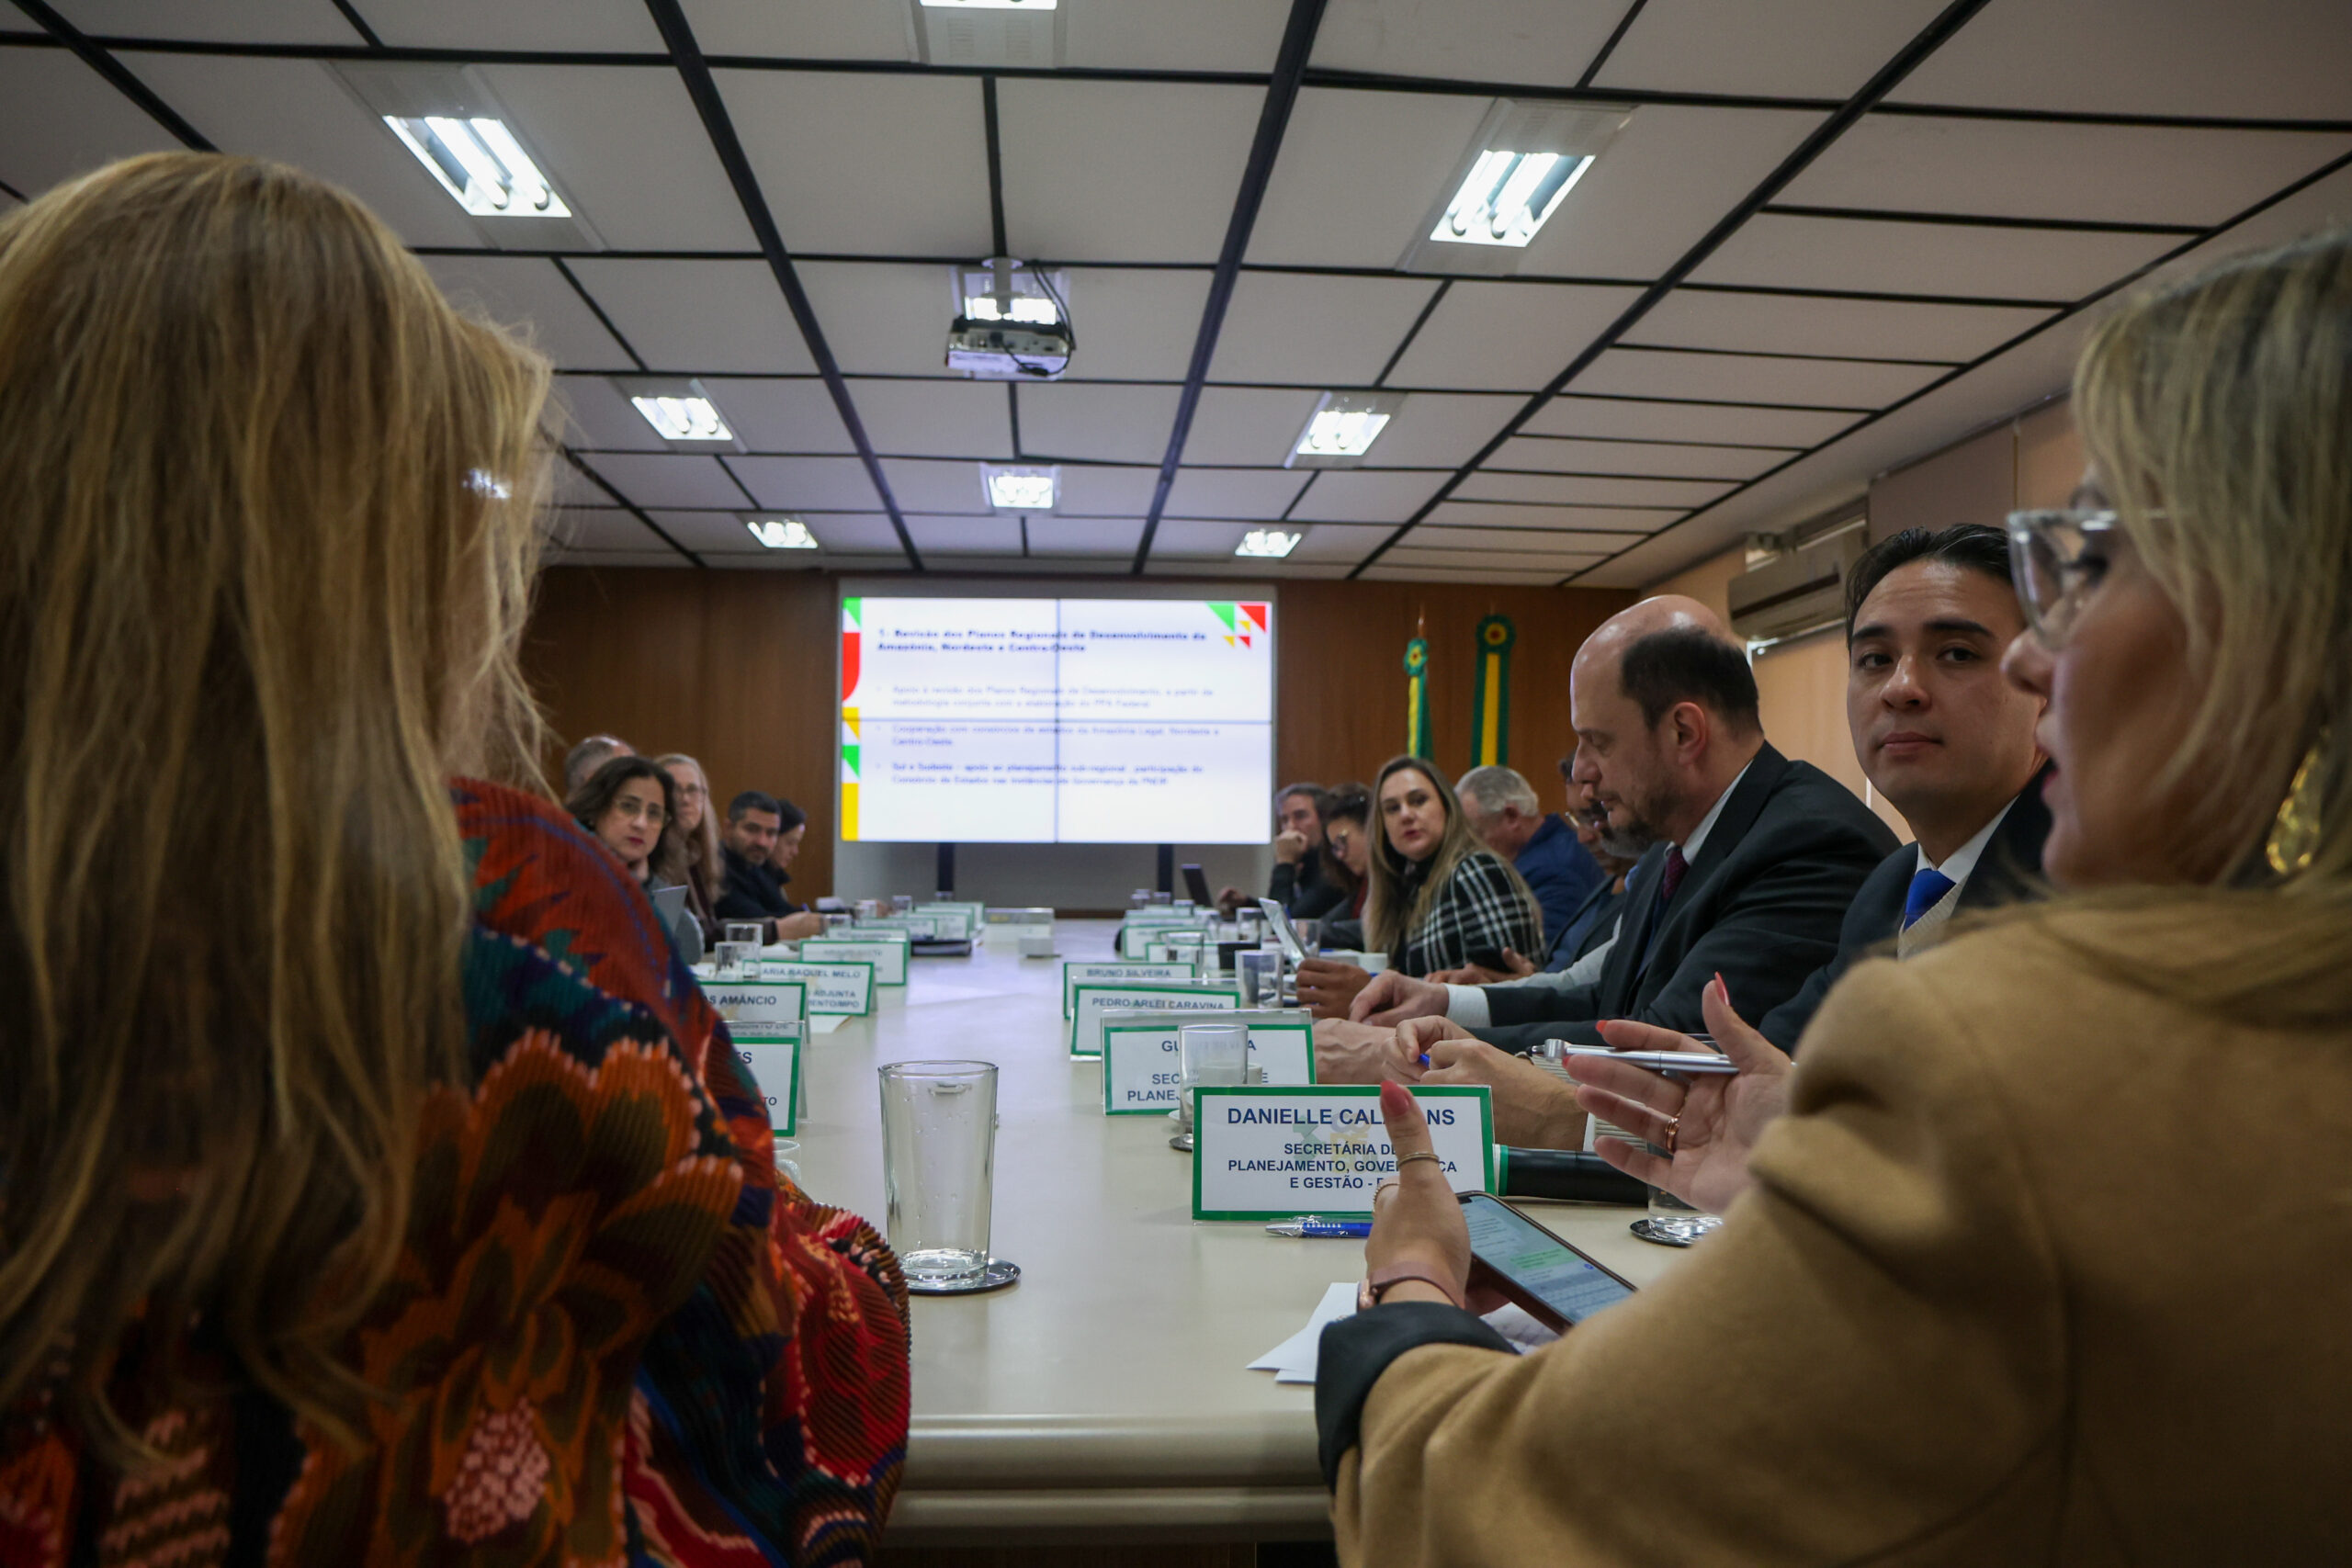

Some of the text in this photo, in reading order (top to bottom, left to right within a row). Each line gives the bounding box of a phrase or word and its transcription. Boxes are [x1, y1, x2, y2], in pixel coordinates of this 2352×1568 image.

[1087, 969, 1123, 977] BRUNO
[719, 994, 776, 1005] AMÂNCIO
[1092, 998, 1130, 1007] PEDRO
[1227, 1108, 1455, 1125] DANIELLE CALNS
[1284, 1141, 1376, 1155] SECRETÁRIA
[1228, 1160, 1350, 1173] PLANEJAMENTO,
[1290, 1178, 1298, 1188] E
[1304, 1175, 1363, 1189] GESTÃO
